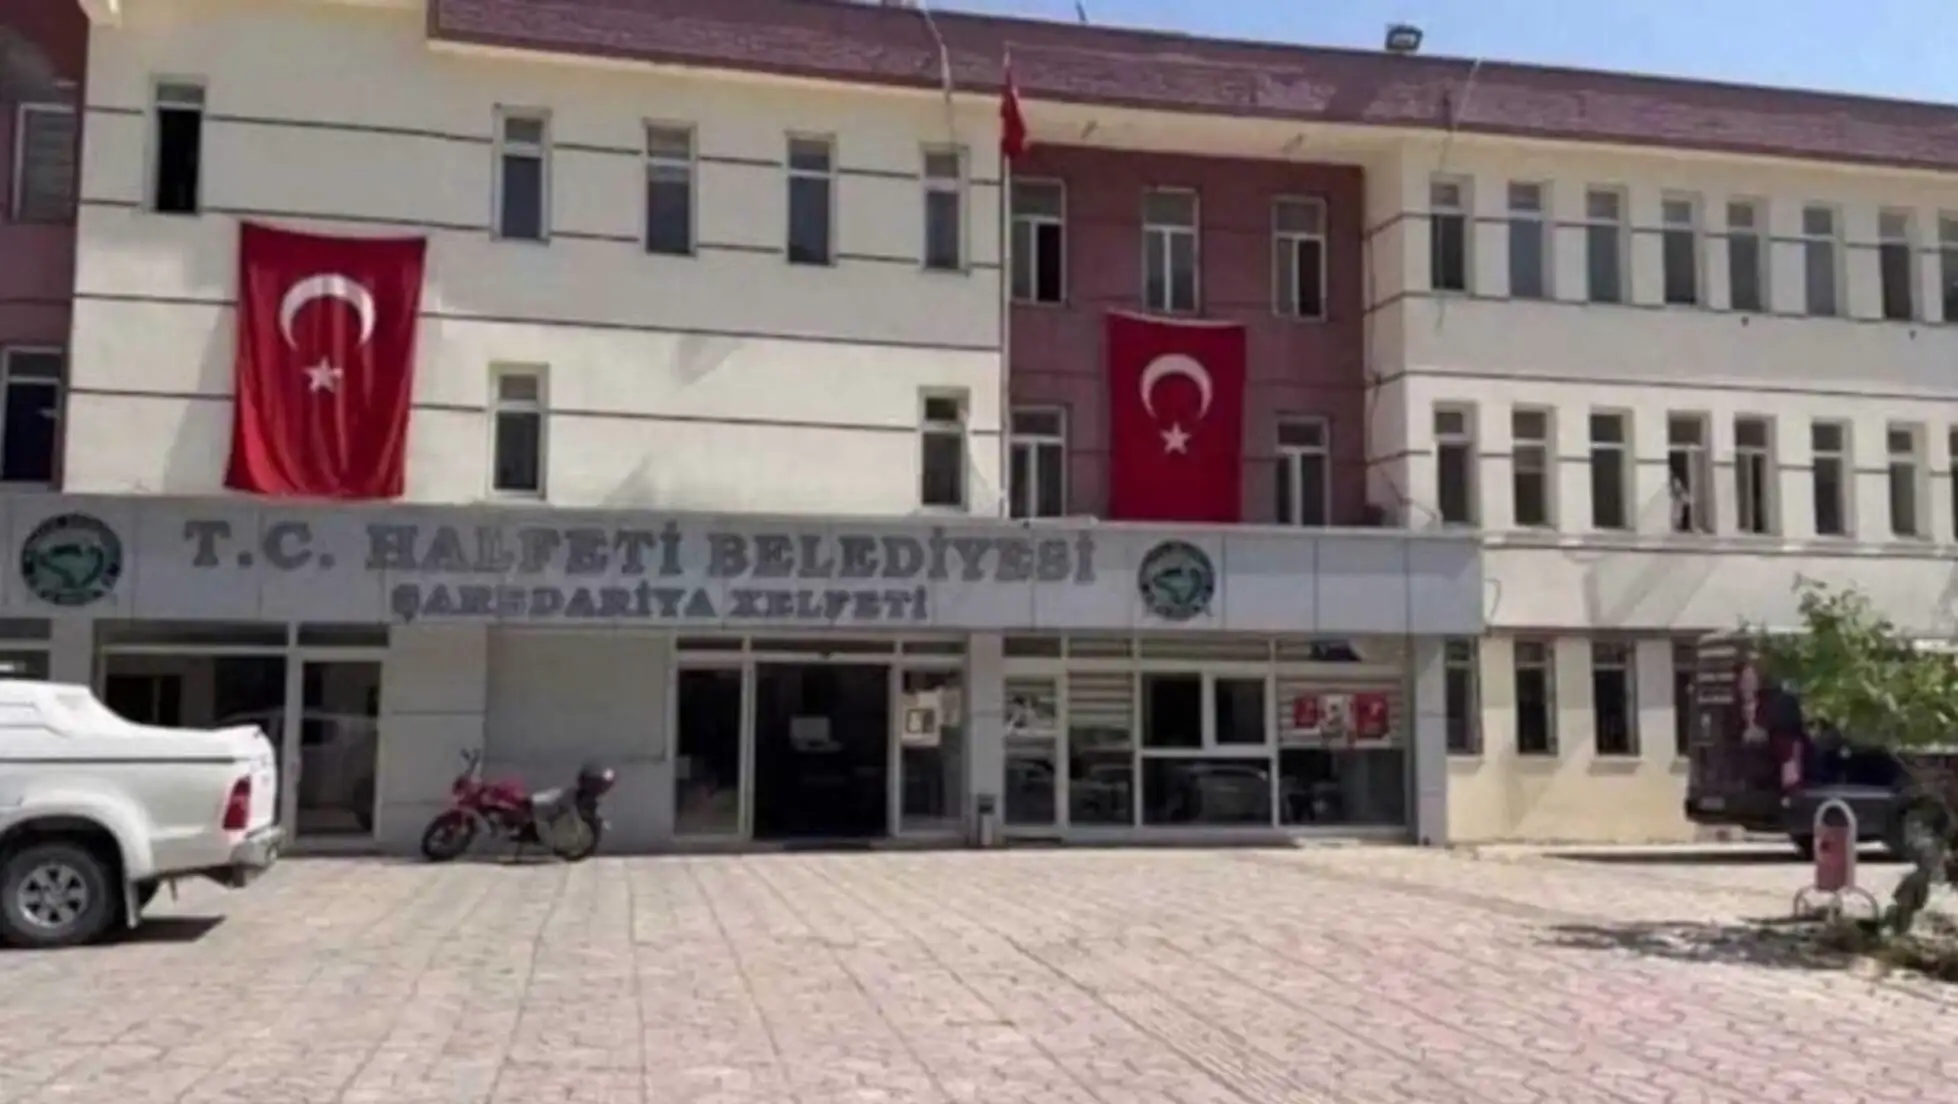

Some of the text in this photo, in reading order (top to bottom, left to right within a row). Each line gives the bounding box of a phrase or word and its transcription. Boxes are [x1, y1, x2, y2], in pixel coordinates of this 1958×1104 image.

[183, 520, 335, 570] T.C.
[365, 521, 684, 576] HALFETİ
[706, 525, 1097, 584] BELEDİYESİ
